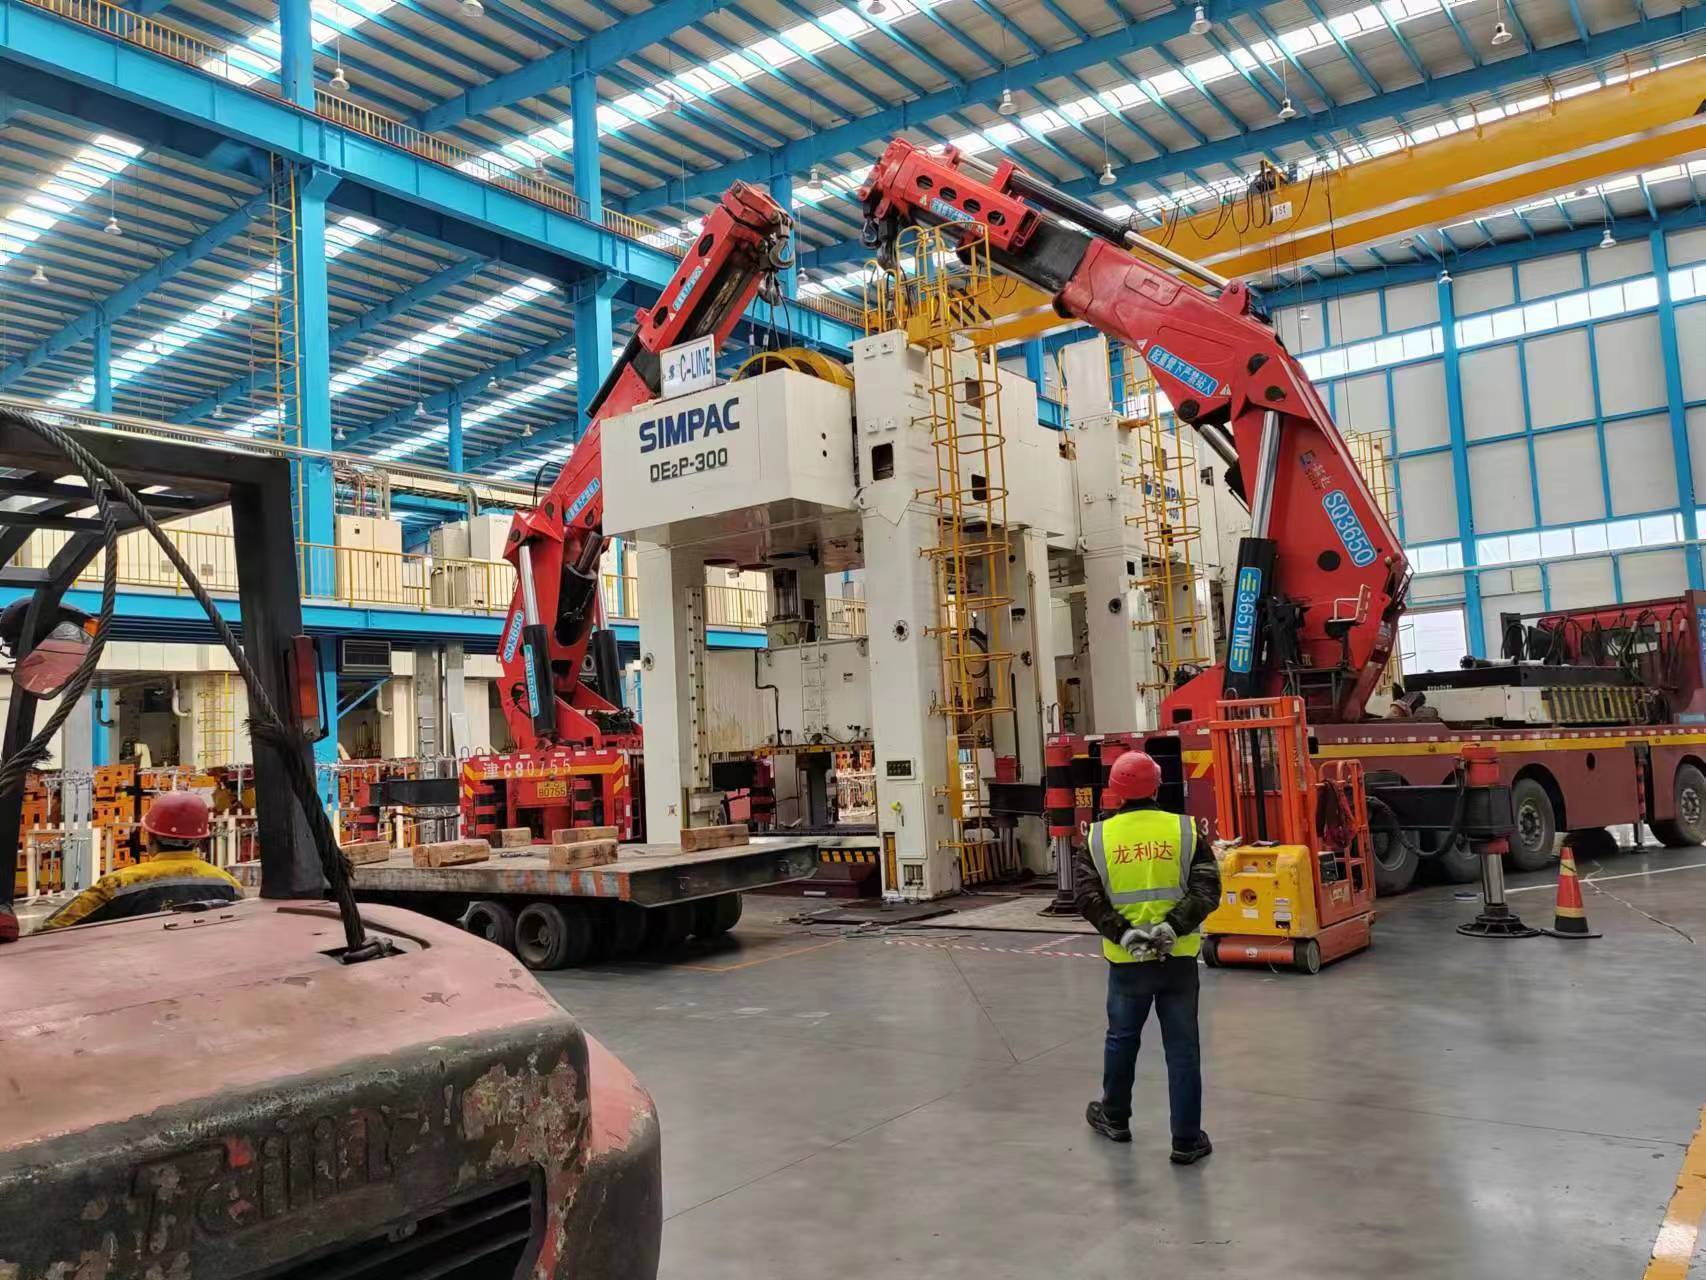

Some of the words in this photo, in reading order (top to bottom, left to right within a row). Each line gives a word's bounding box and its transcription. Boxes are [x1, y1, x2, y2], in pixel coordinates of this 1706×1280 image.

[639, 397, 740, 453] SIMPAC
[1325, 492, 1374, 563] SQ3650
[1234, 592, 1256, 648] 365TM
[1112, 840, 1174, 865] 龙利达
